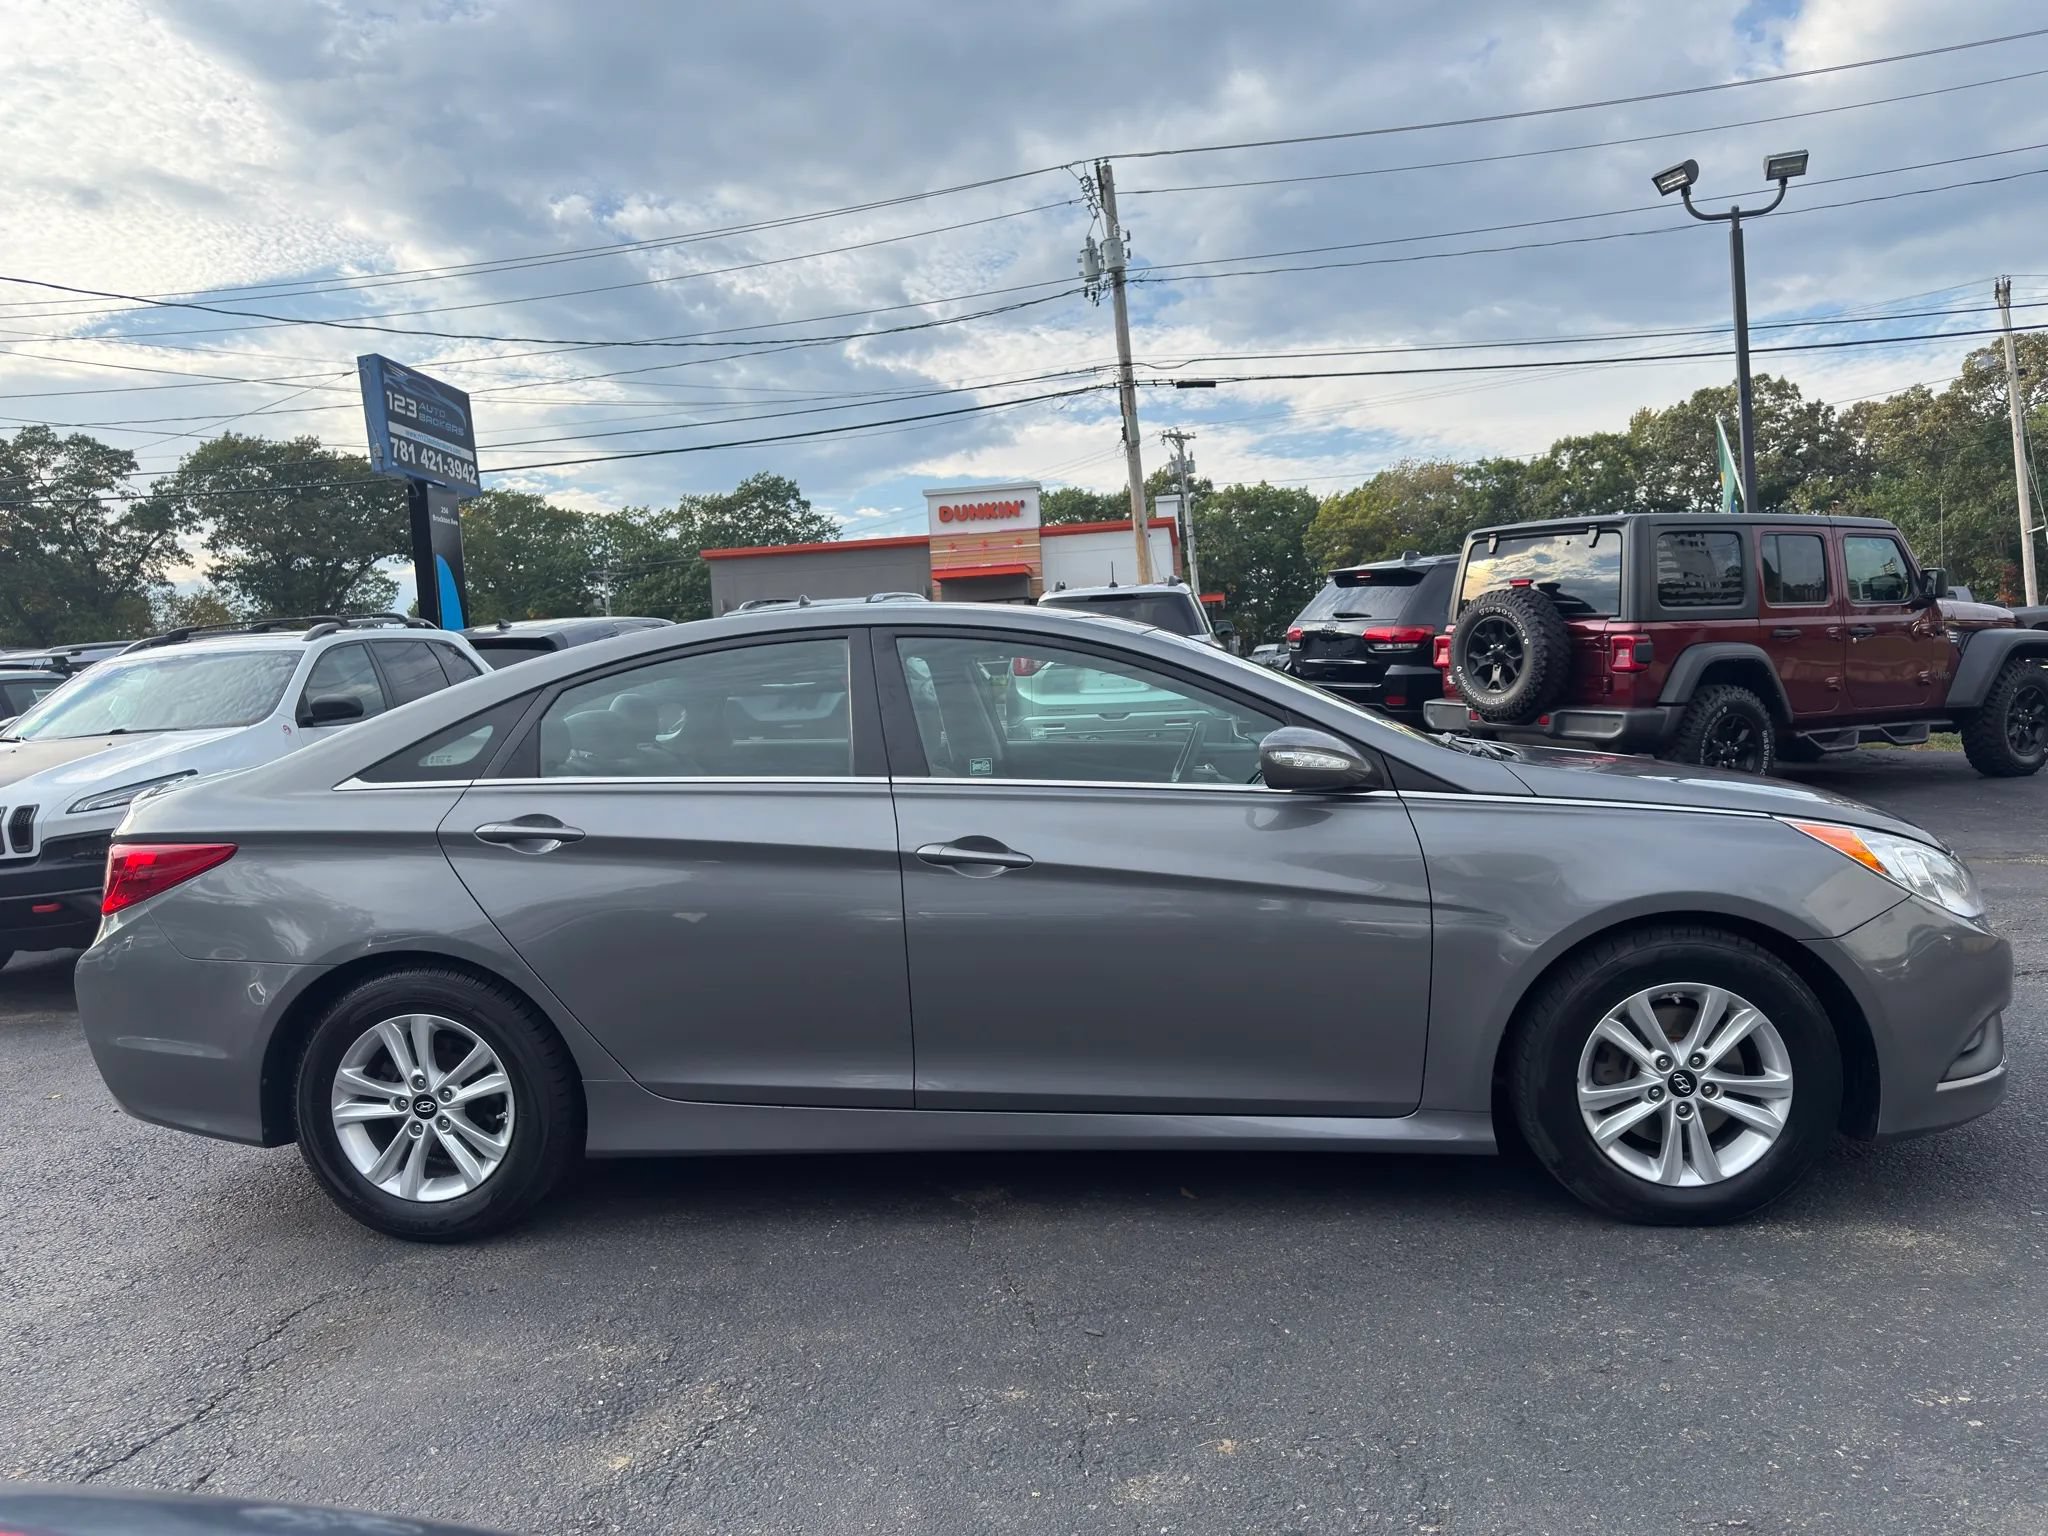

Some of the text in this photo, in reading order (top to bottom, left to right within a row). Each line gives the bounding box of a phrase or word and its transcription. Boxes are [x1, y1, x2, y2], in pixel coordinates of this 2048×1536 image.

[386, 390, 417, 418] 123
[418, 402, 446, 418] AUTO
[418, 412, 464, 436] BROKERS
[390, 436, 416, 464] 781
[420, 448, 477, 485] 421-3942
[938, 499, 1026, 523] DUNKIN'
